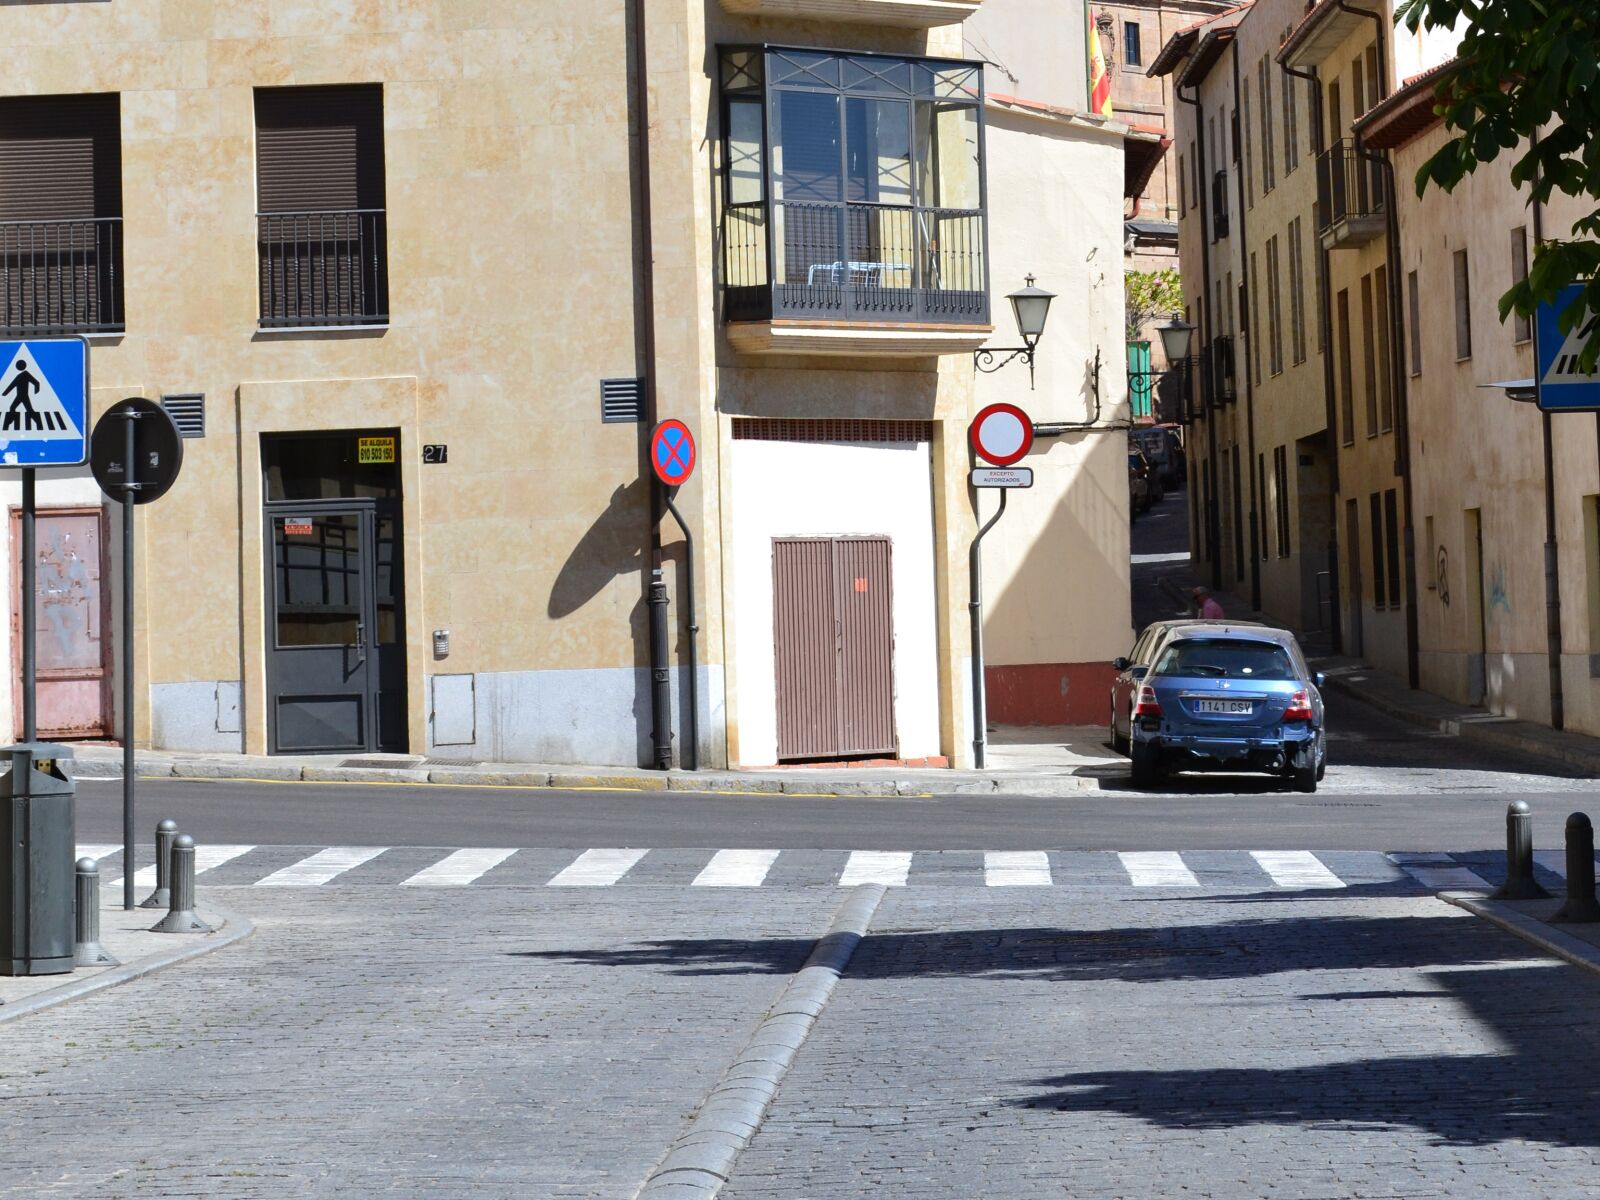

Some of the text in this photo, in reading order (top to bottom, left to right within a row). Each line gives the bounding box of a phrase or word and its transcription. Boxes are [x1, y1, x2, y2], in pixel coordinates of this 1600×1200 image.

[370, 439, 393, 447] ALQUILA
[371, 447, 382, 460] 503
[424, 445, 445, 462] 27
[1201, 701, 1251, 713] 1141 CSV
